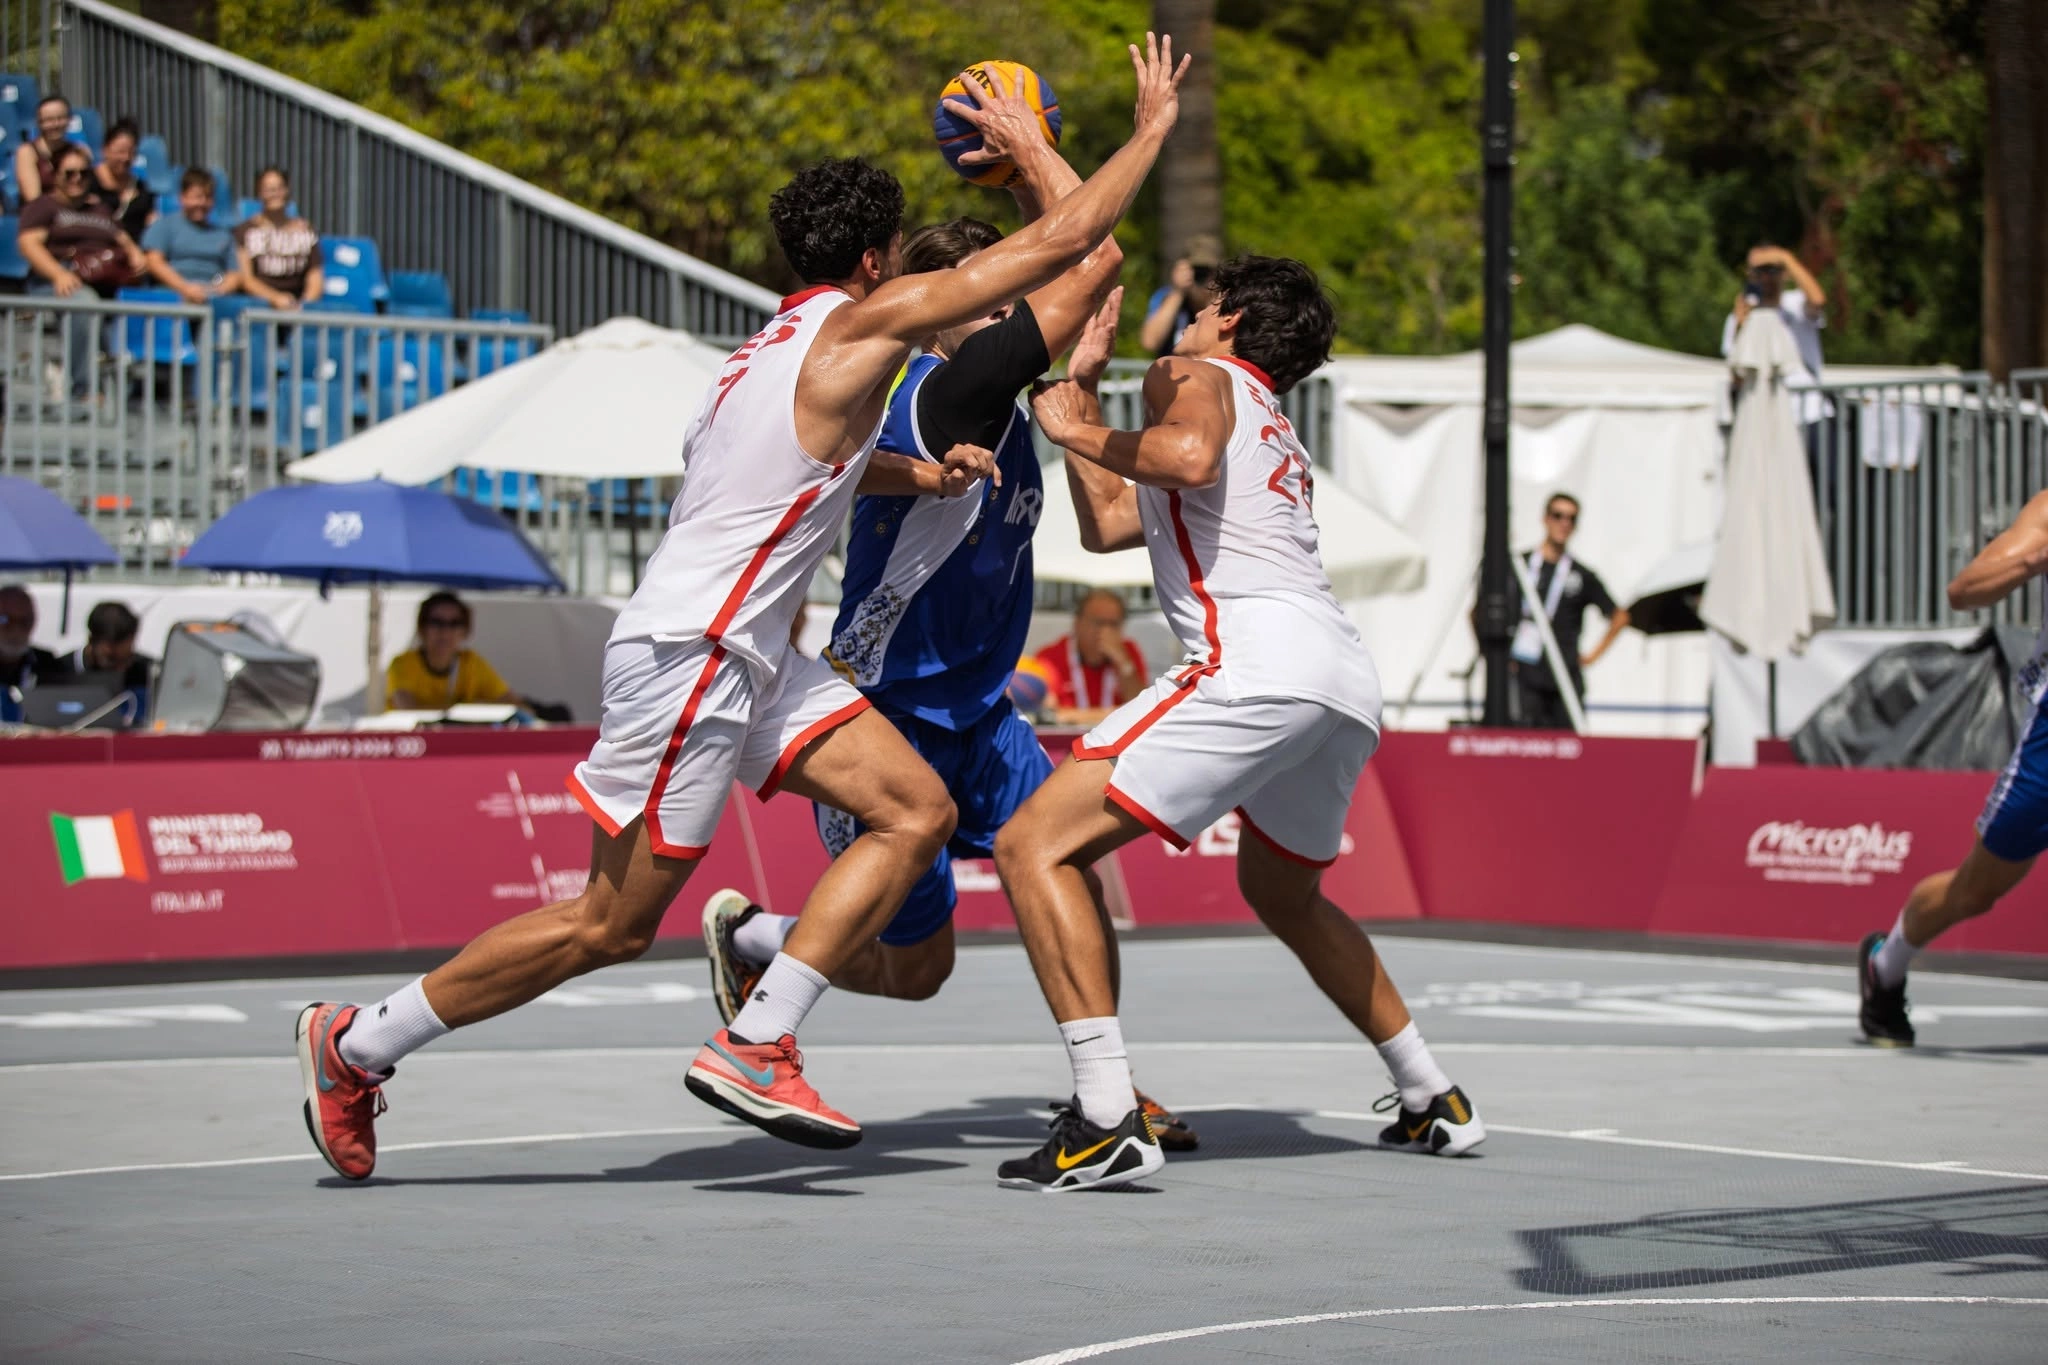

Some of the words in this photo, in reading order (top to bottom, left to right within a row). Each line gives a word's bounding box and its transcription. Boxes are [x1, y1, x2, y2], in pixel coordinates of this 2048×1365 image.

[147, 813, 263, 833] MINISTERO
[152, 833, 199, 856] DEL
[200, 830, 293, 853] TURISMO
